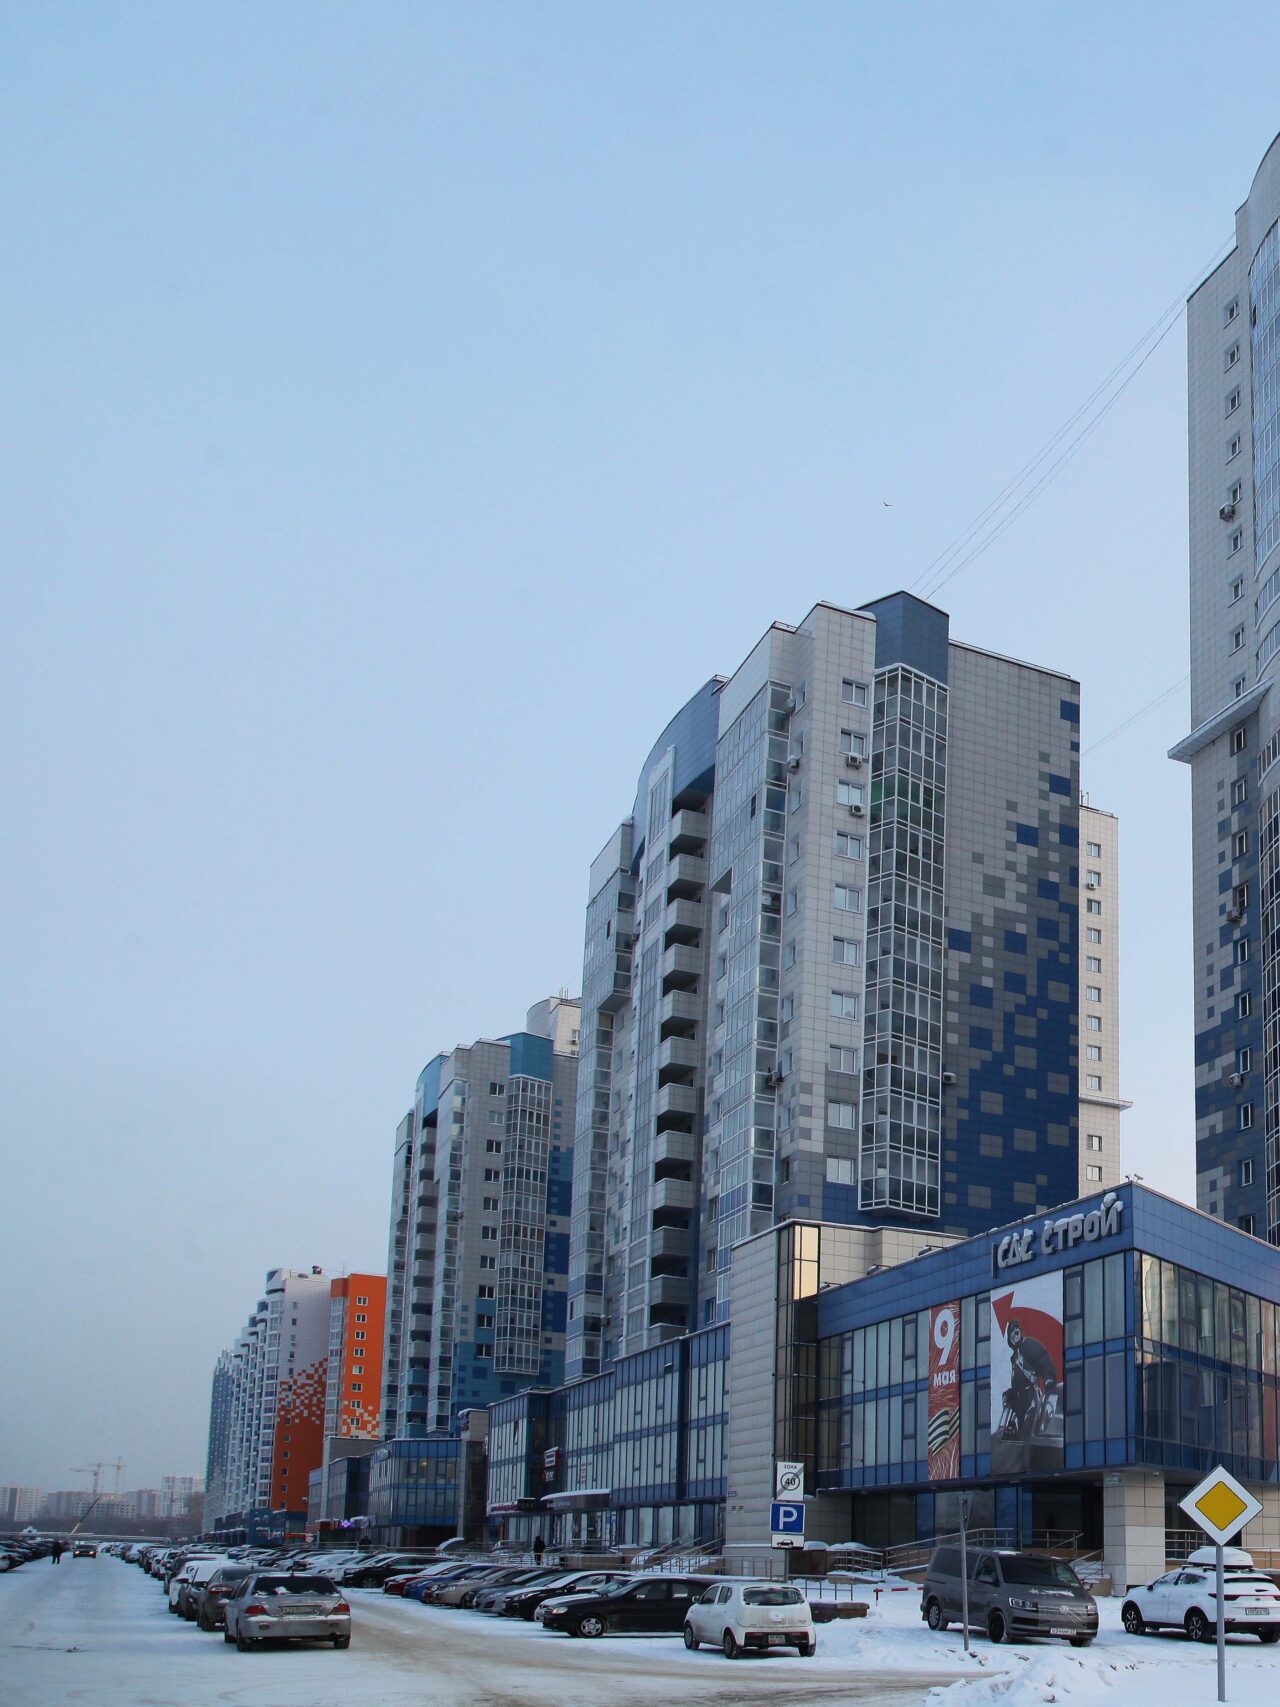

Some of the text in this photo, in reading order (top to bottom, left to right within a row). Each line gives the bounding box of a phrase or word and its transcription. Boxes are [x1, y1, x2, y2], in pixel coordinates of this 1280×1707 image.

[998, 1194, 1123, 1268] СДС СТРОЙ
[934, 1309, 955, 1365] 9
[784, 1477, 796, 1486] 40
